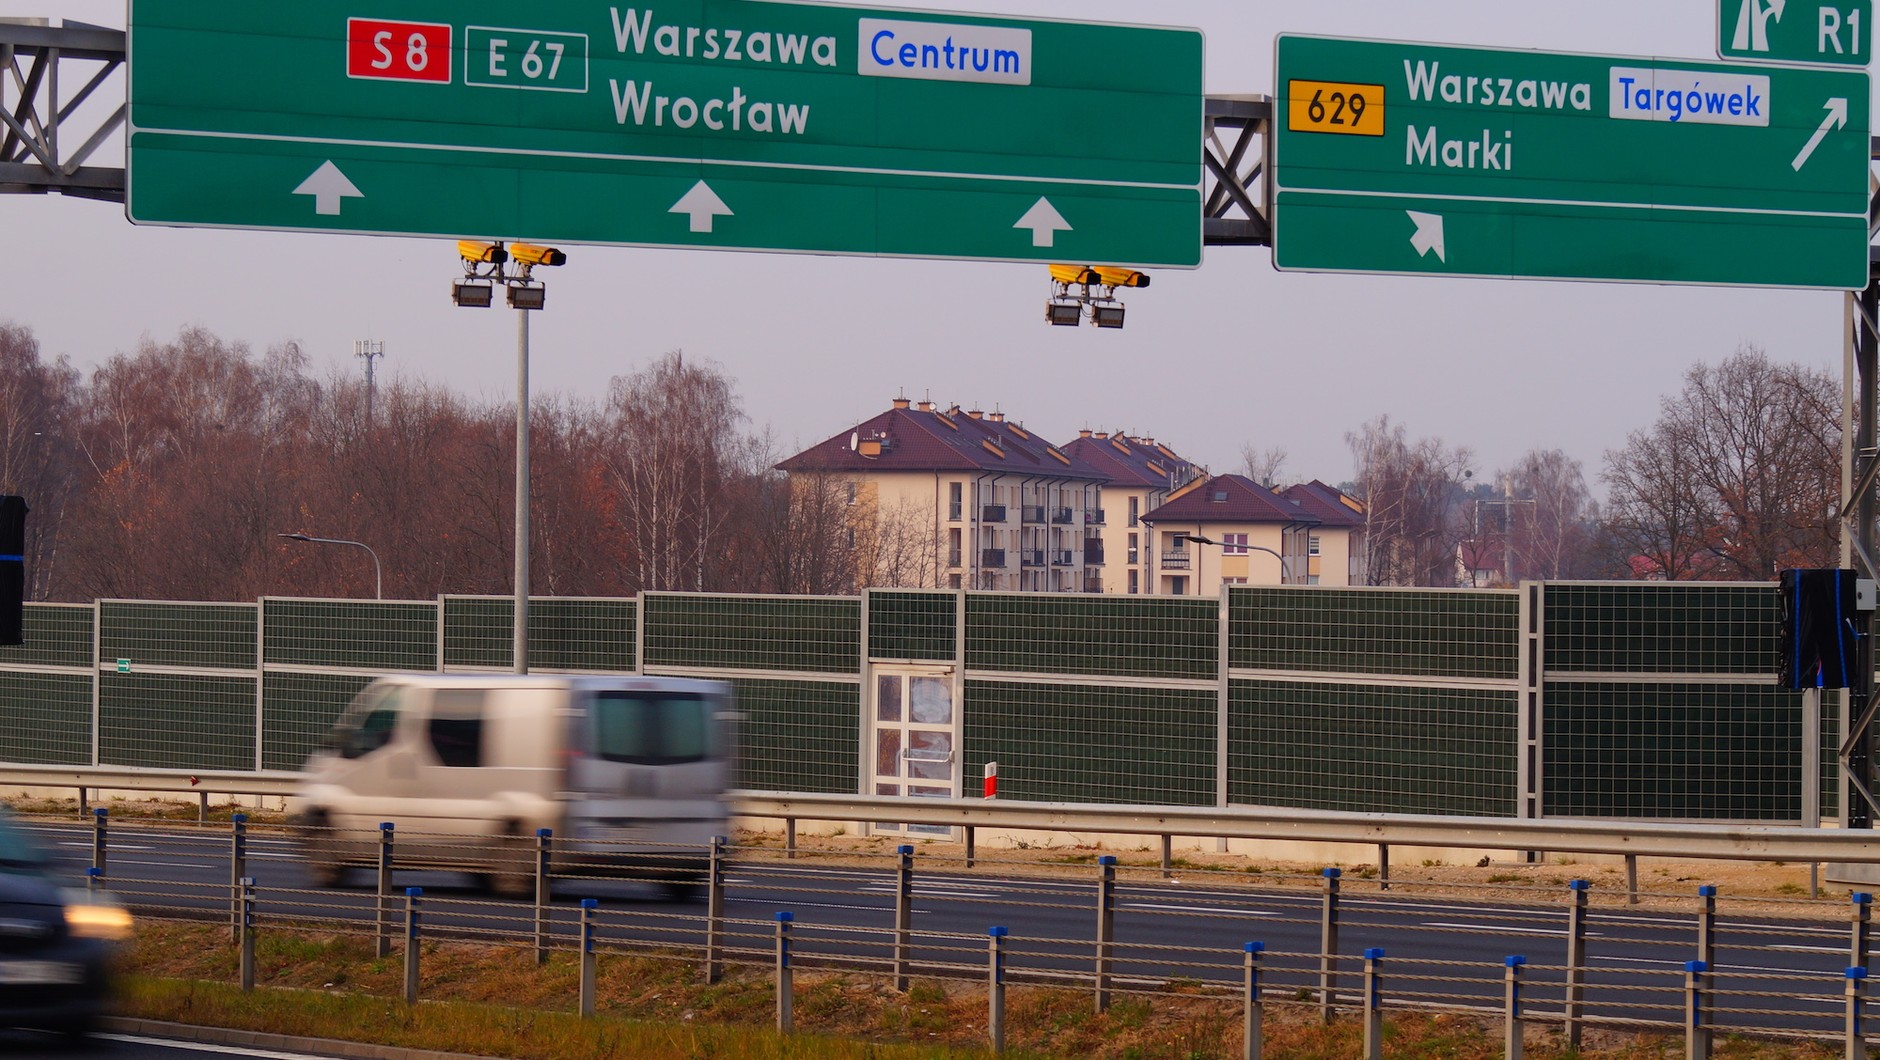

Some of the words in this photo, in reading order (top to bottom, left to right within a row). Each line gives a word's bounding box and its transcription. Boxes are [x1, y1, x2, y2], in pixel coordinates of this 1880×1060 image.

[372, 31, 393, 69] S
[407, 33, 428, 72] 8
[610, 7, 837, 67] Warszawa
[870, 30, 1020, 74] Centrum
[1818, 7, 1860, 55] R1
[489, 38, 508, 77] E
[522, 41, 565, 80] 67
[609, 79, 810, 135] Wrocław
[1403, 59, 1592, 111] Warszawa
[1618, 77, 1761, 122] Targówek
[1307, 89, 1366, 128] 629
[1406, 125, 1512, 170] Marki
